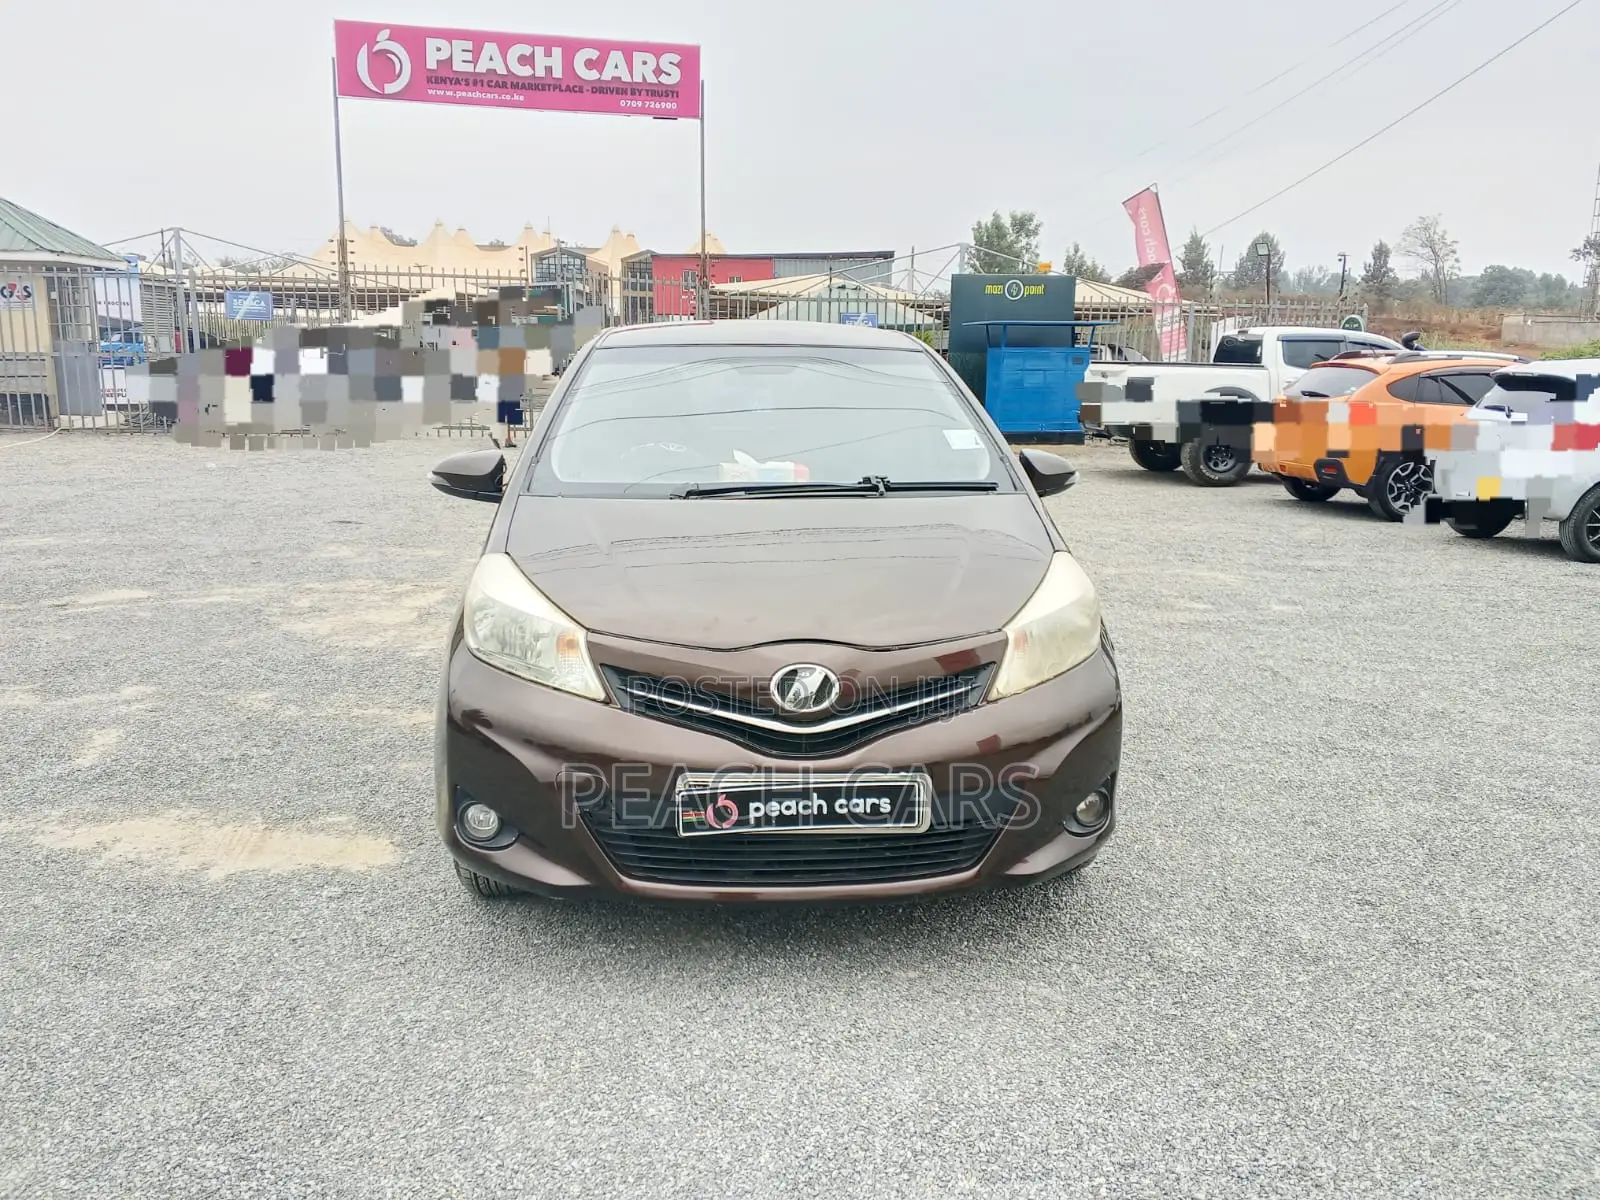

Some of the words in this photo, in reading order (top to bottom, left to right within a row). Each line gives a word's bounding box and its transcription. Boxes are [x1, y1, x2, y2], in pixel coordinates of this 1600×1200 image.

[425, 37, 563, 79] PEACH
[573, 47, 682, 85] CARS
[426, 75, 470, 87] KENYA'S
[486, 80, 508, 90] CAR
[510, 81, 585, 94] MARKETPLACE
[590, 86, 629, 96] DRIVEN
[630, 88, 643, 97] BY
[427, 88, 525, 102] www.peachcars.co.ke
[620, 99, 643, 108] 0709
[749, 792, 828, 824] peach
[834, 796, 892, 815] cars
